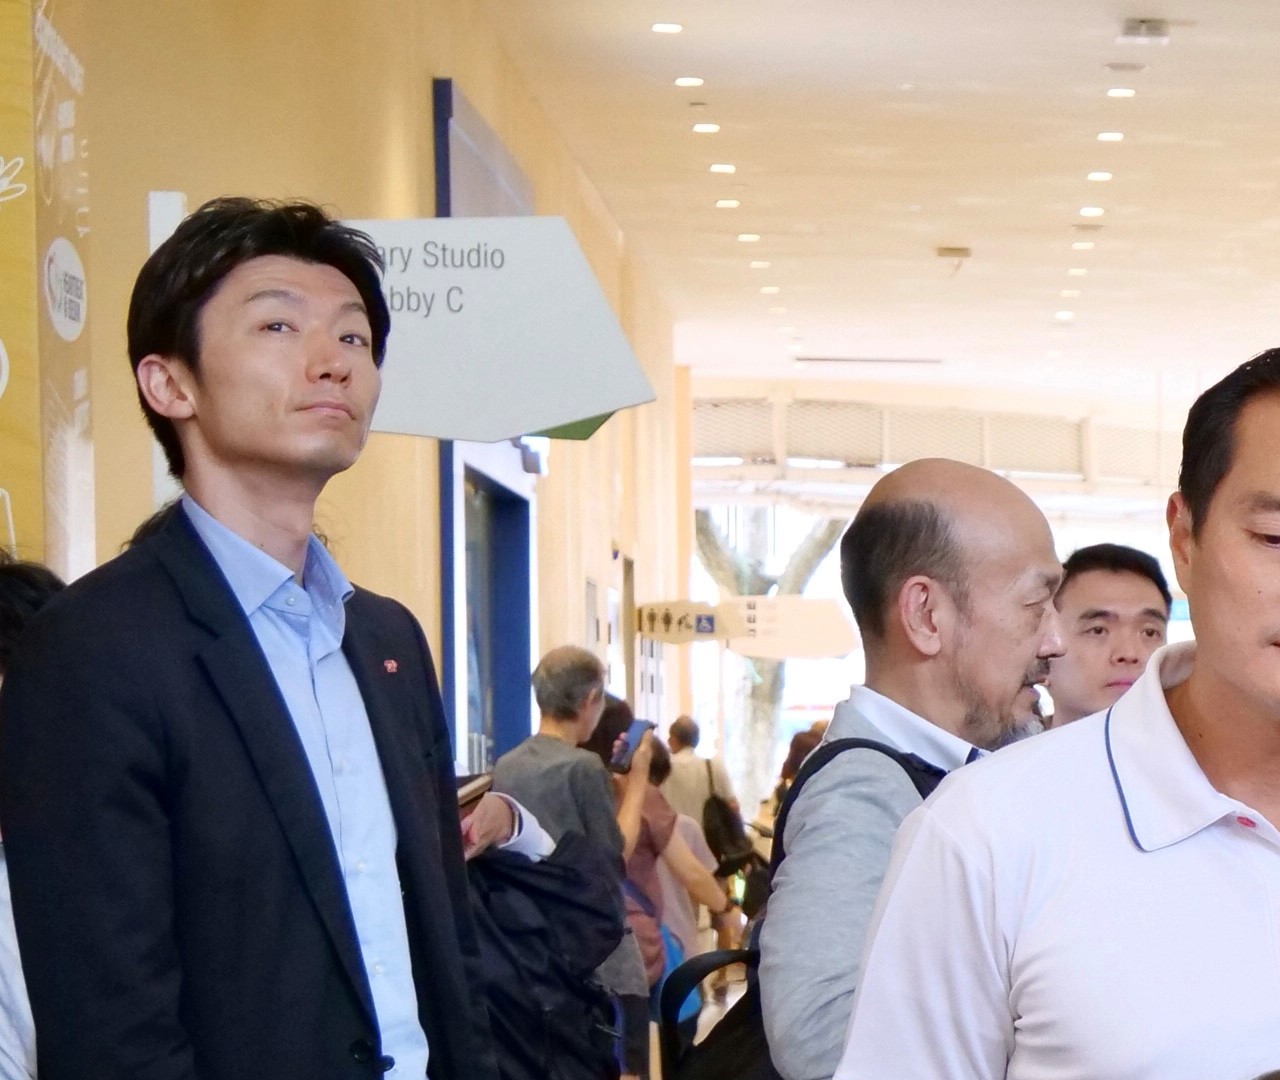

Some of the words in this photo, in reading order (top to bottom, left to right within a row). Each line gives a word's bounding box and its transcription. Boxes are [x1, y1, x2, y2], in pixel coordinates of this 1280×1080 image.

[376, 244, 413, 273] ary
[423, 240, 505, 270] Studio
[384, 285, 436, 319] bby
[446, 285, 464, 313] C
